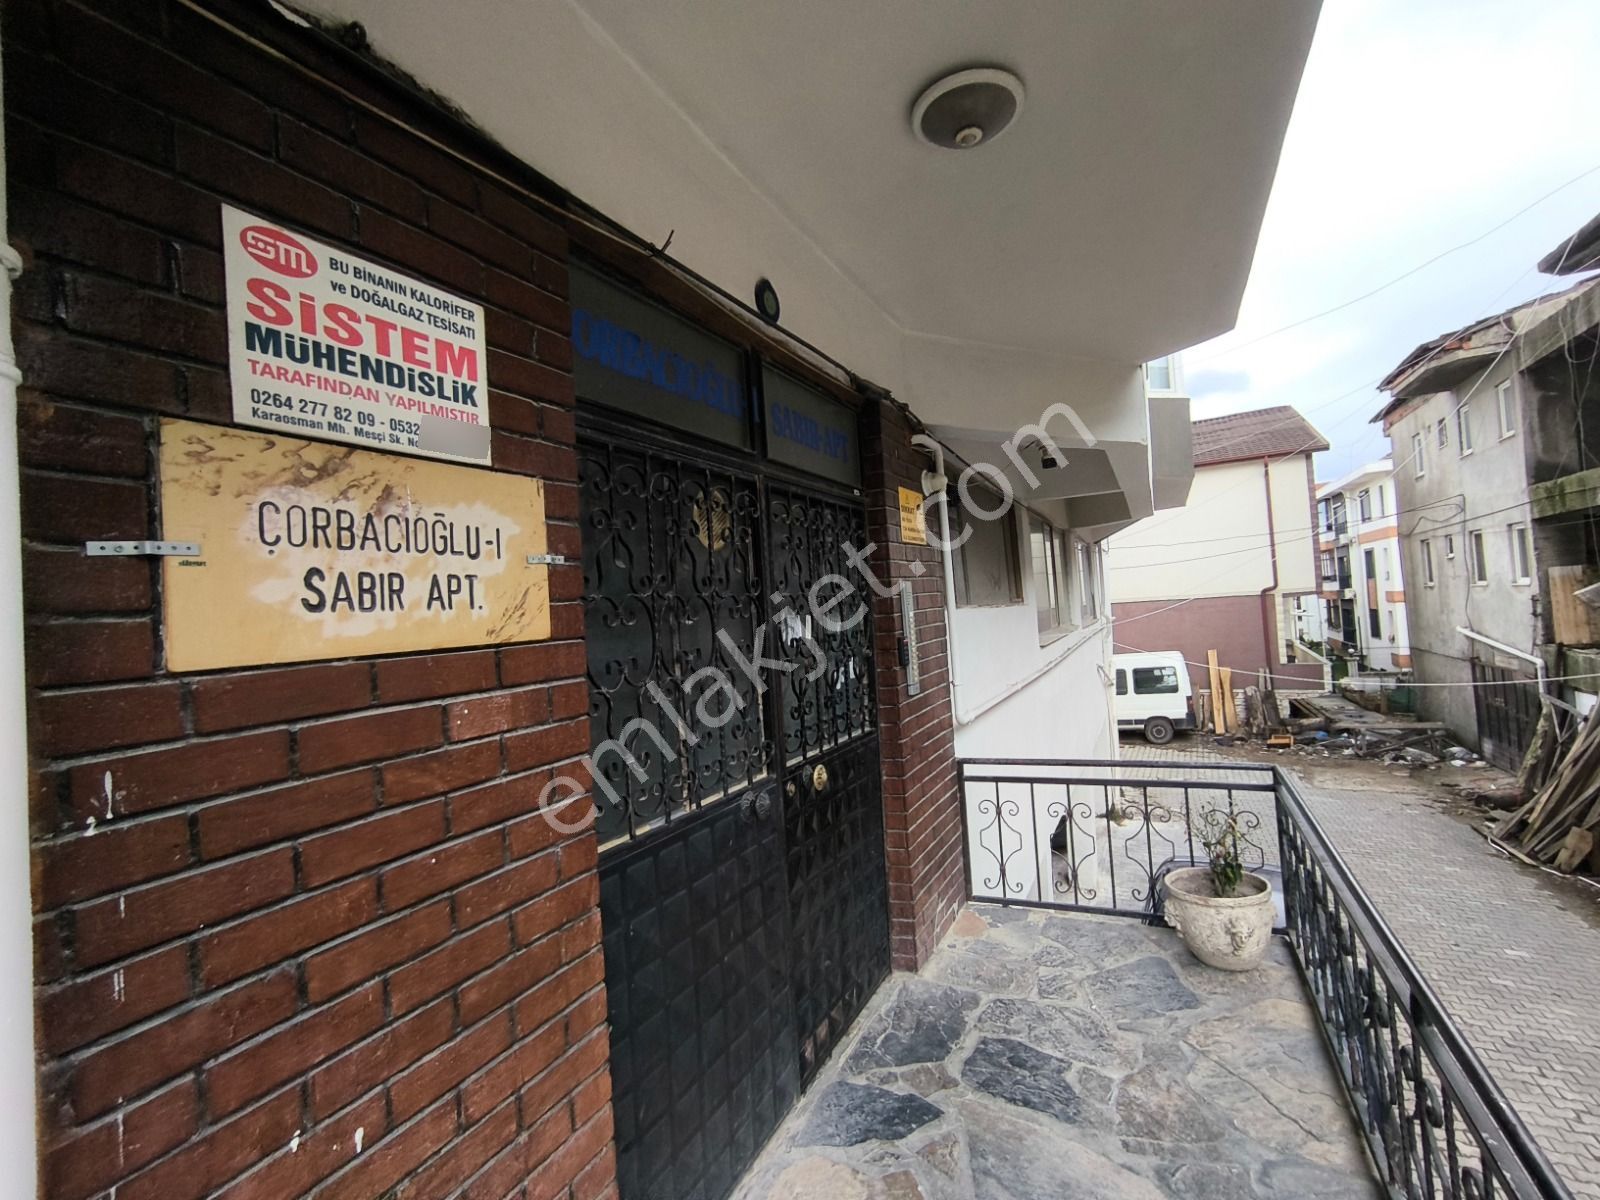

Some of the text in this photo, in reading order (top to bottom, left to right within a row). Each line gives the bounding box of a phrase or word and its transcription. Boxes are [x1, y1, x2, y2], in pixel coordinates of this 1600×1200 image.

[329, 257, 475, 322] BU BİNANIN KALORİFER
[330, 280, 475, 340] ve DOĞALGAZ TESİSATI
[247, 358, 380, 404] TARAFINDAN
[251, 388, 293, 410] 0264
[299, 399, 328, 417] 277
[334, 406, 352, 422] 82
[357, 411, 375, 427] 09
[389, 418, 420, 437] 0532
[251, 407, 323, 431] Karaosman
[327, 421, 350, 435] Mh.
[354, 427, 386, 444] Mesçi
[388, 433, 404, 446] Sk.
[300, 567, 484, 613] SABIR APT.
